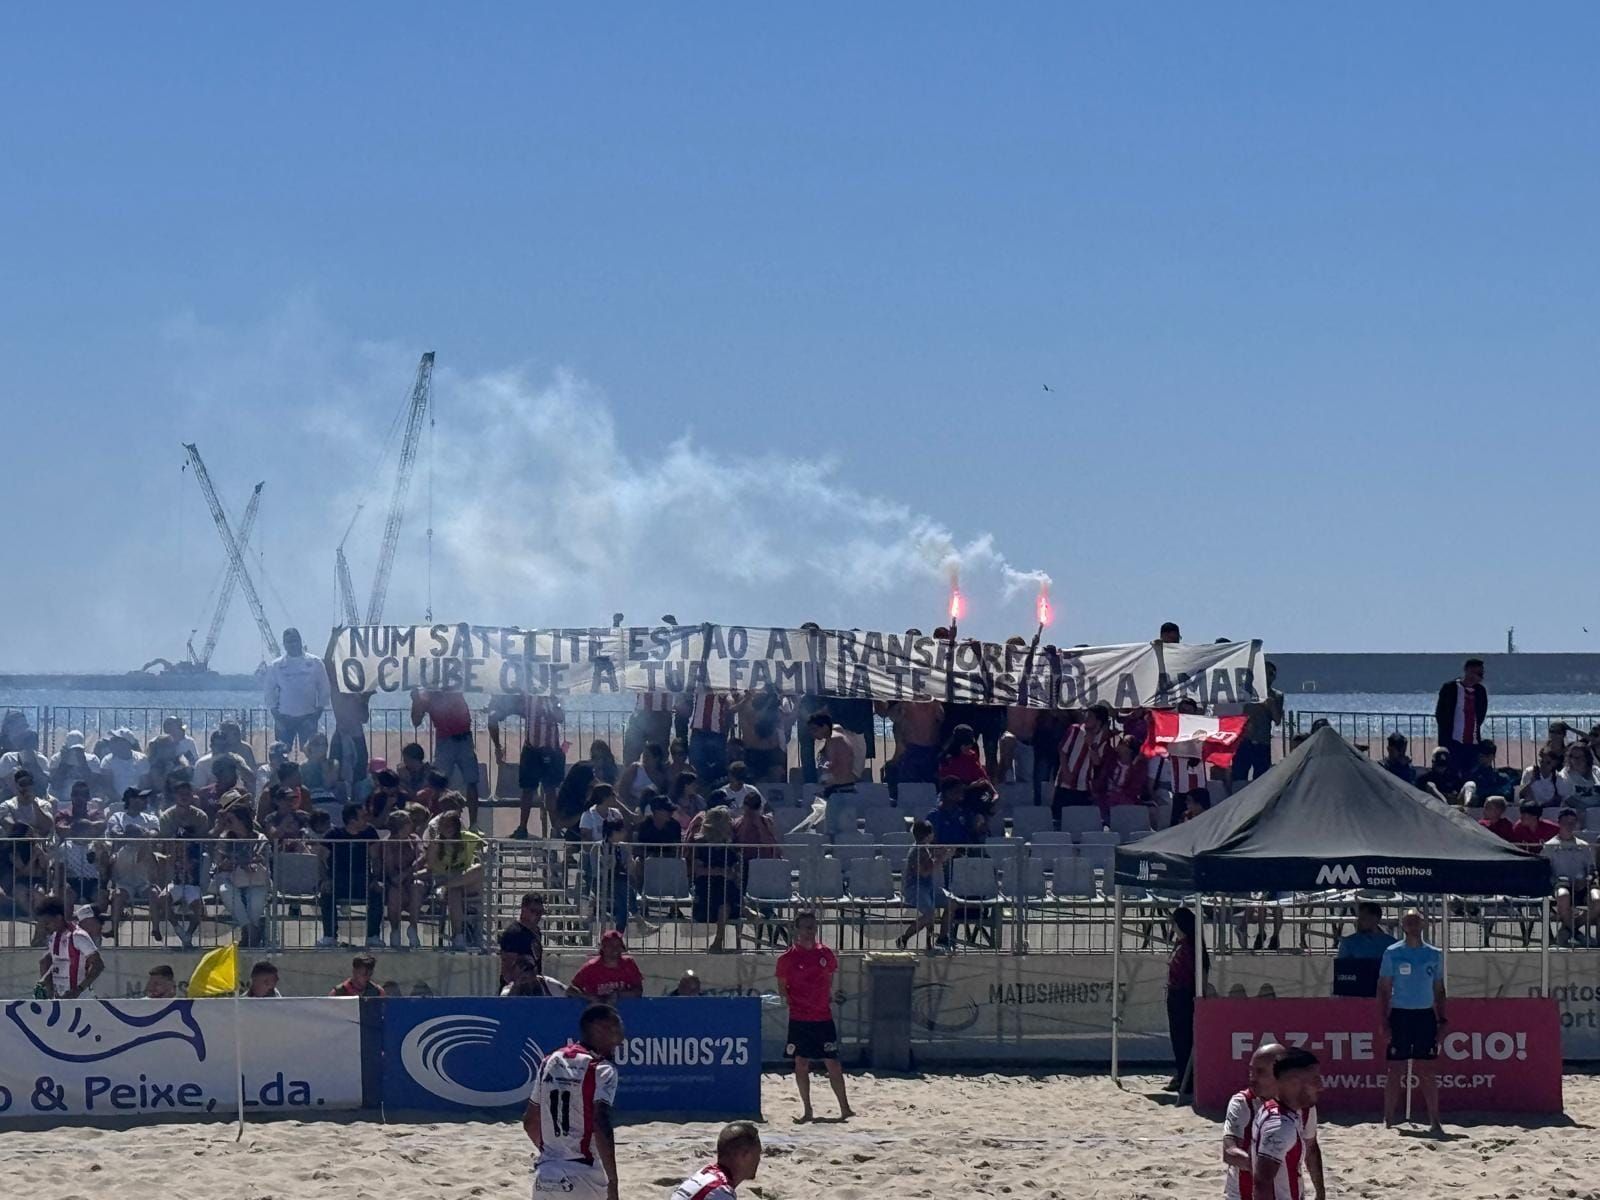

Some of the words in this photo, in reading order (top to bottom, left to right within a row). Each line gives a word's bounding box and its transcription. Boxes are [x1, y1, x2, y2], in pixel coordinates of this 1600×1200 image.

[350, 625, 415, 657] NUM
[430, 623, 610, 662] SATELITE
[766, 627, 792, 660] A
[342, 659, 365, 692] O
[378, 657, 484, 692] CLUBE
[500, 662, 569, 695] QUE
[592, 657, 619, 693] A
[640, 661, 711, 693] TUA
[886, 665, 932, 701] TE
[1114, 673, 1139, 707] A
[1366, 865, 1432, 876] matosinhos
[1367, 877, 1396, 886] sport
[1560, 1008, 1596, 1028] ort
[1437, 1032, 1527, 1060] CIO!
[30, 1076, 68, 1111] &
[86, 1074, 216, 1112] Peixe,
[550, 1089, 570, 1137] 11
